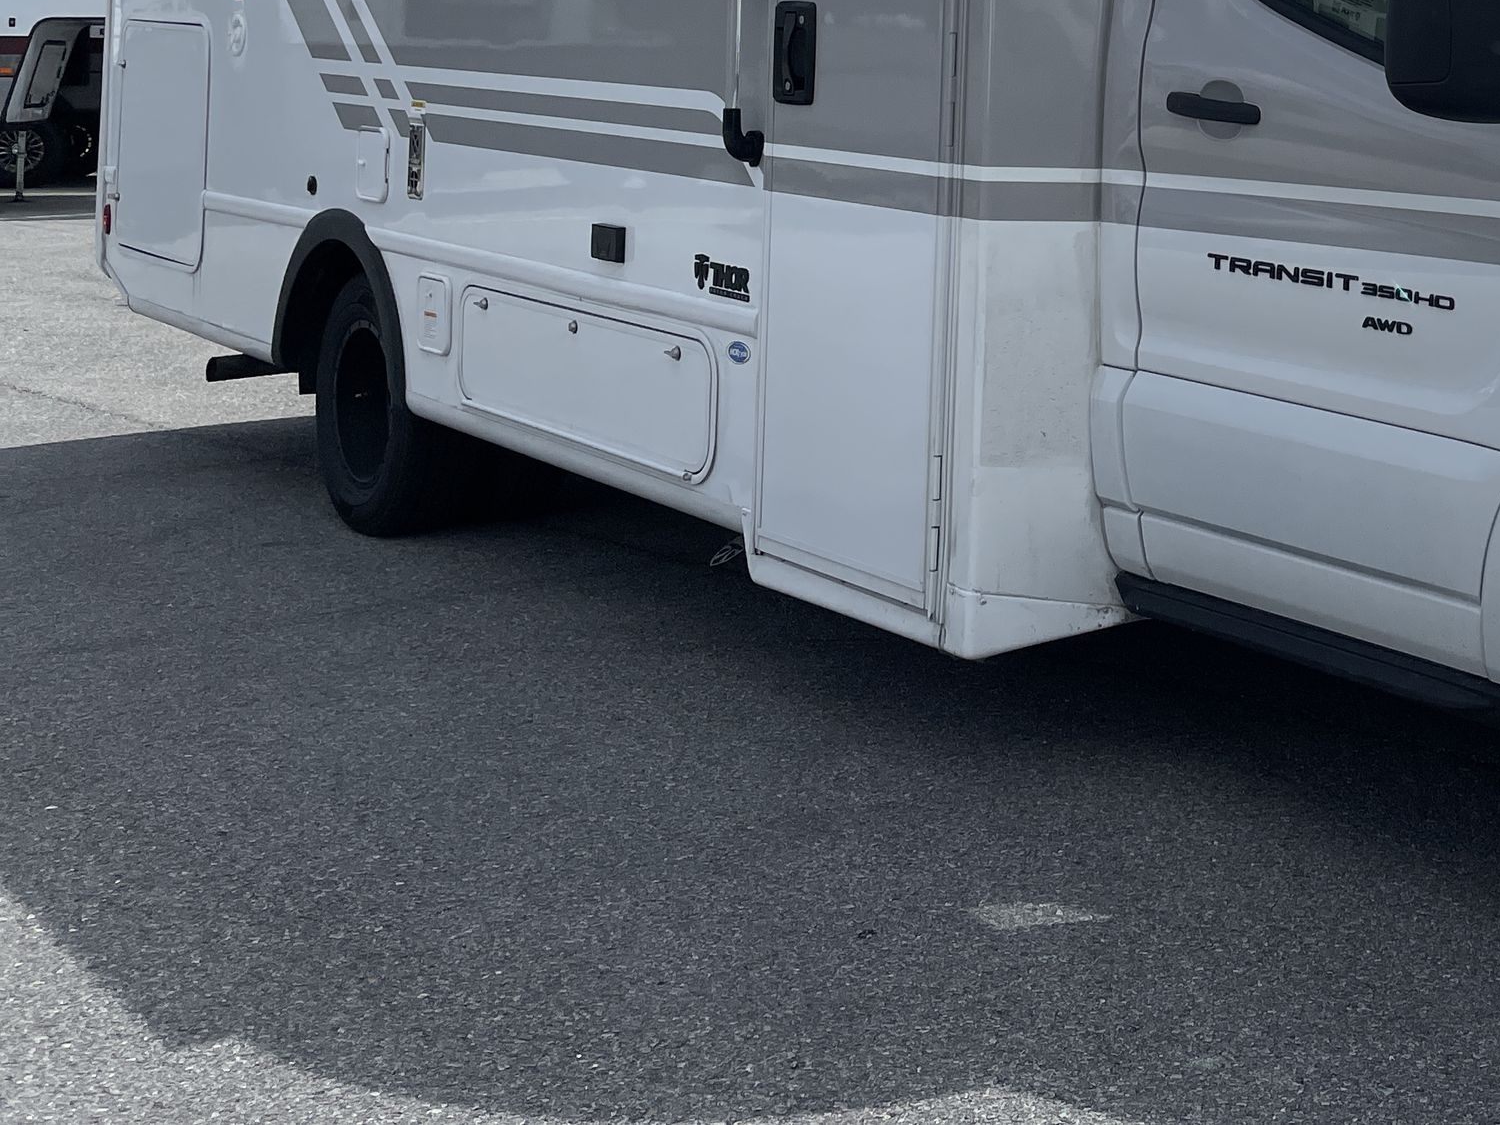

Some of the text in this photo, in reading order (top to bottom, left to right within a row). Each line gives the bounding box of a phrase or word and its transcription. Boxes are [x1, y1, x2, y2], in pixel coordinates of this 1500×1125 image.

[709, 261, 750, 294] THOR
[1207, 252, 1456, 311] TRANSIT 350HD
[1361, 315, 1413, 336] AWD
